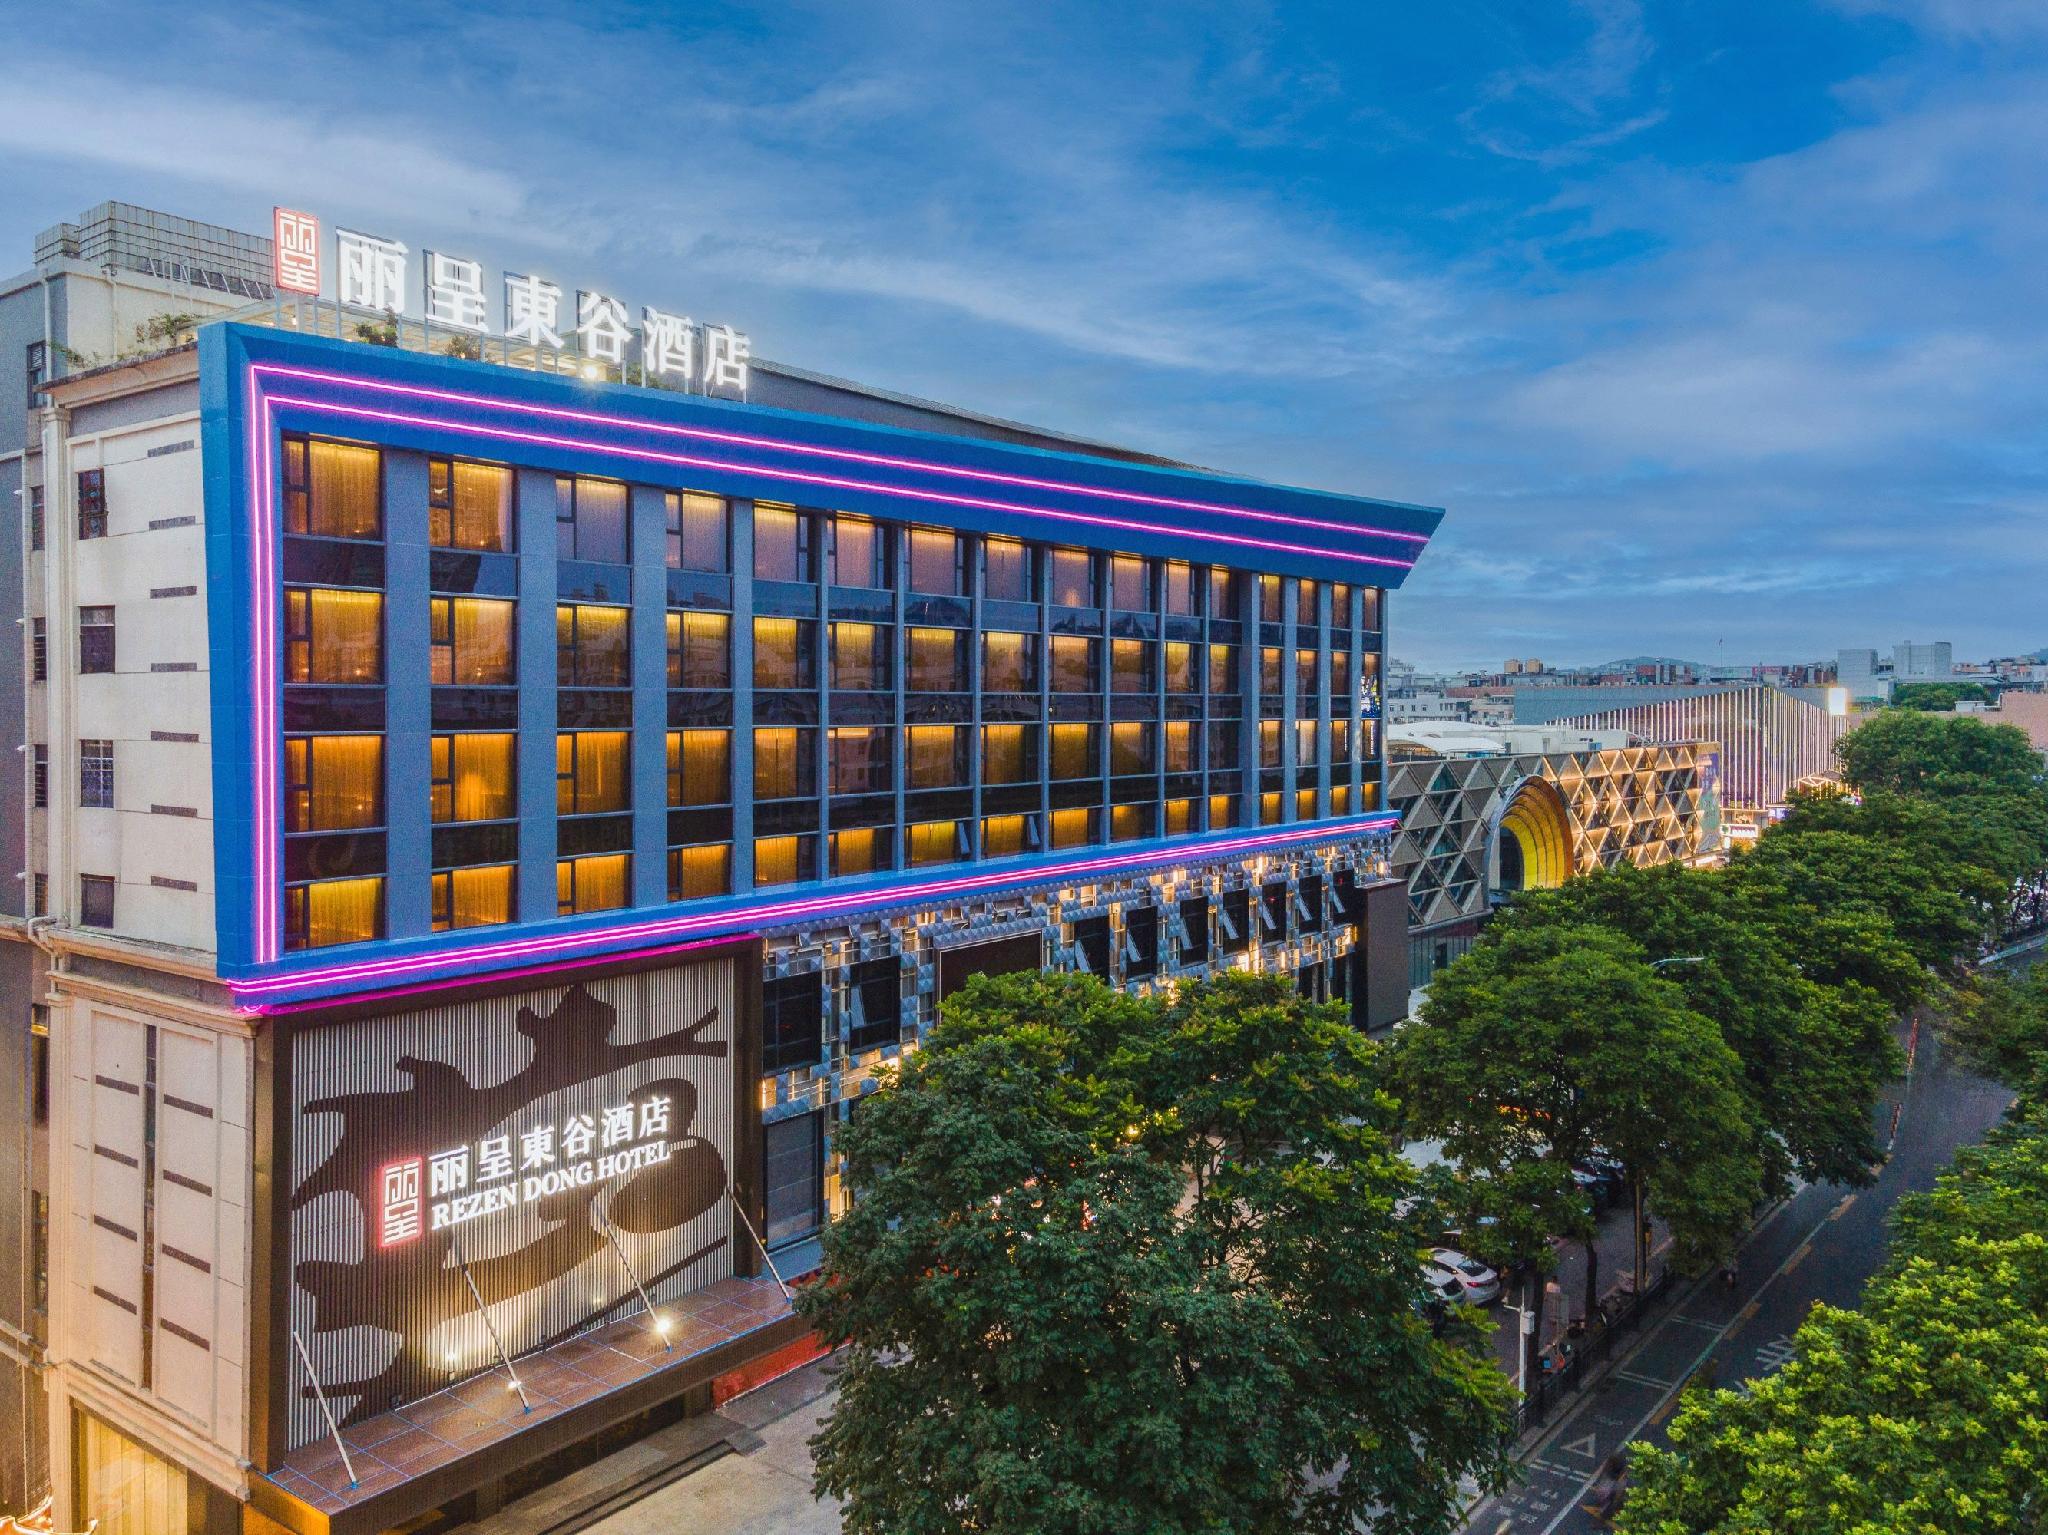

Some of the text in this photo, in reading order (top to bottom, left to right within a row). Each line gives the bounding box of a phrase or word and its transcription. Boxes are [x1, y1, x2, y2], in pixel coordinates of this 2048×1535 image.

[336, 225, 752, 392] 丽呈東谷酒店
[429, 1096, 672, 1197] 丽呈東谷酒店
[431, 1139, 671, 1231] REZEN DONG HOTEL
